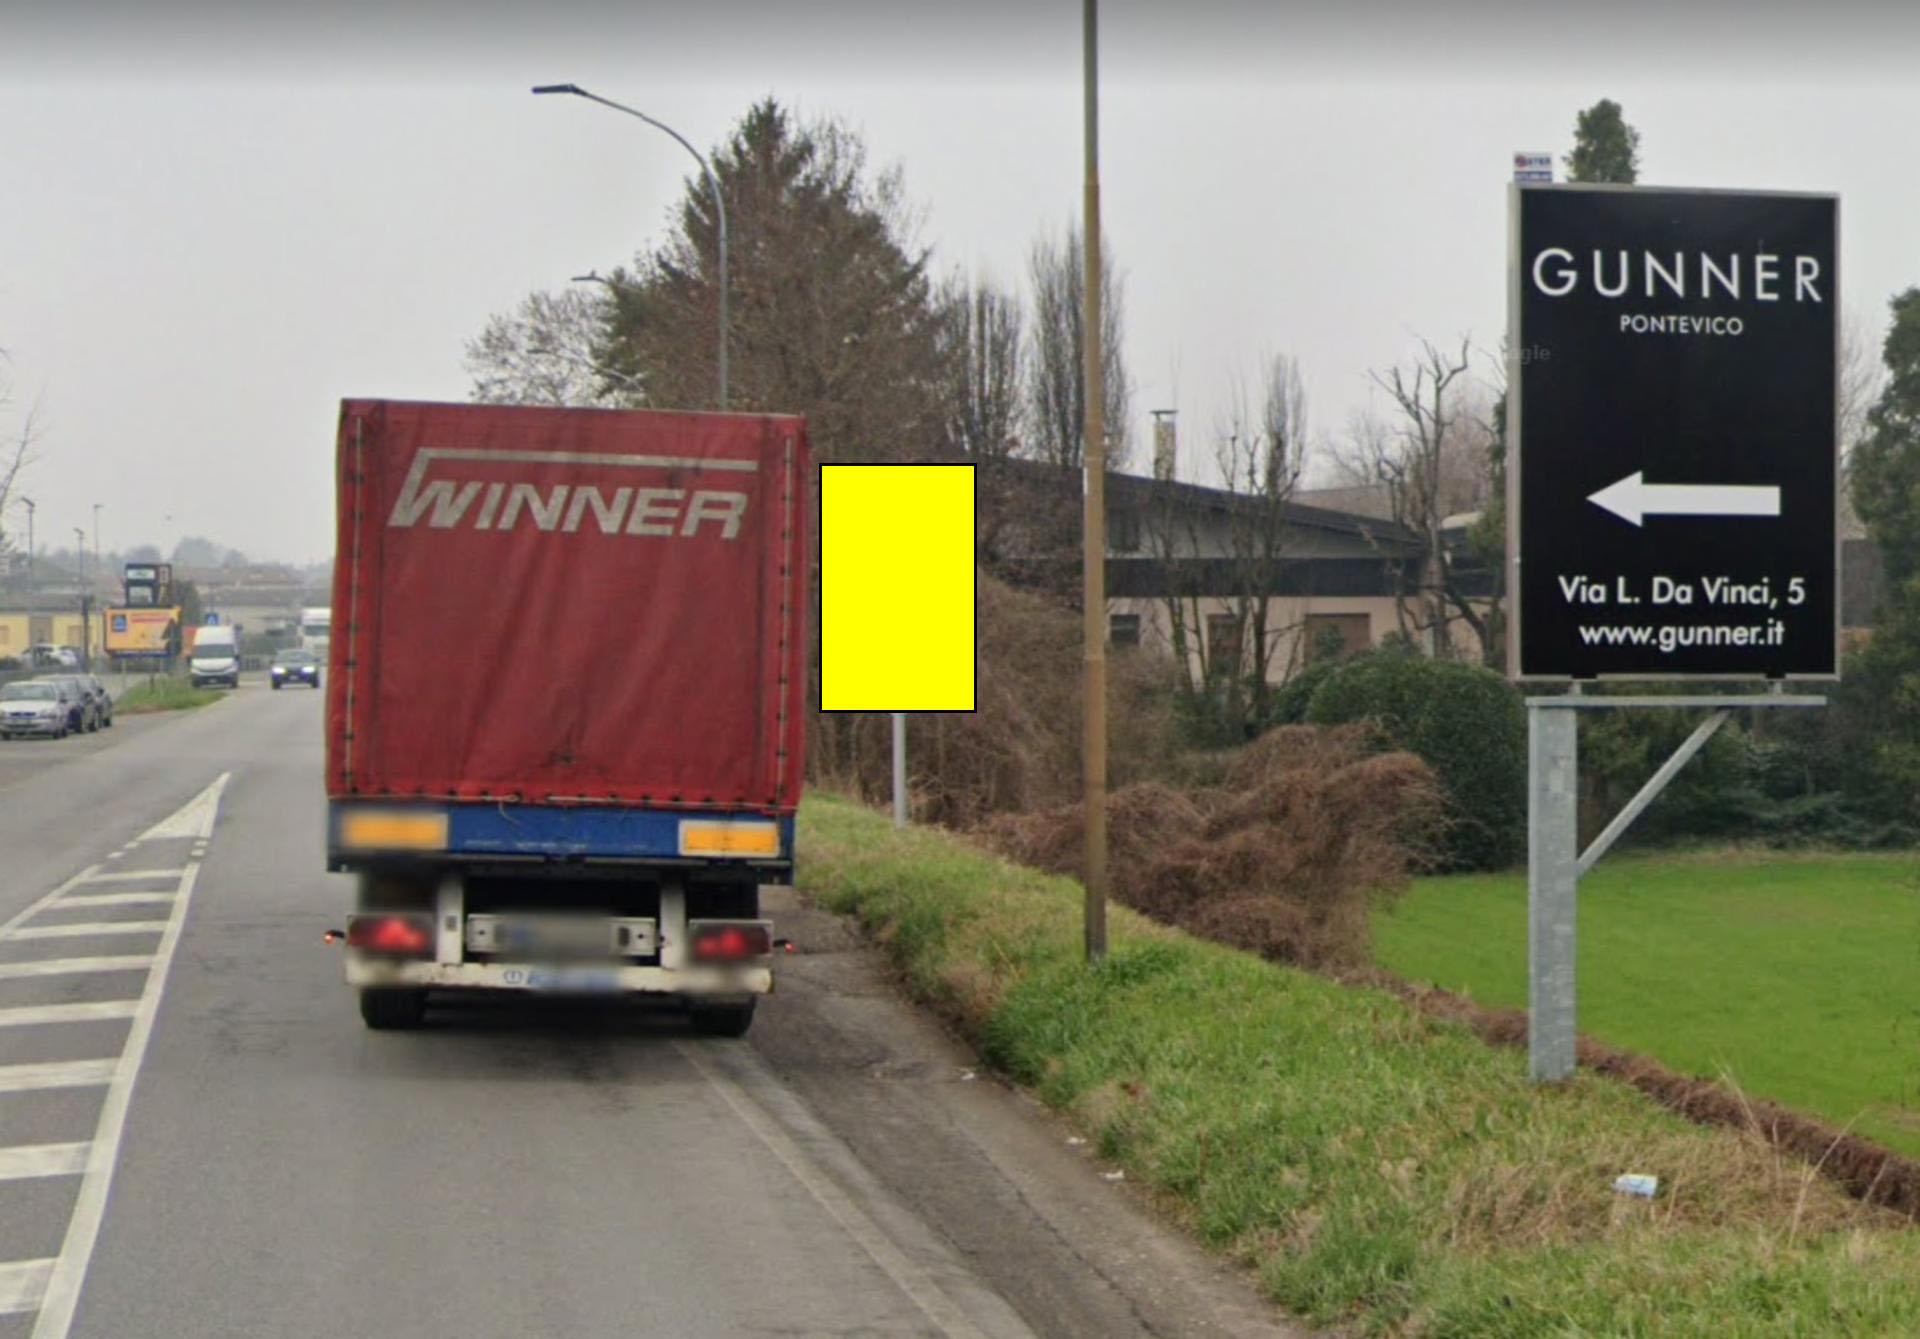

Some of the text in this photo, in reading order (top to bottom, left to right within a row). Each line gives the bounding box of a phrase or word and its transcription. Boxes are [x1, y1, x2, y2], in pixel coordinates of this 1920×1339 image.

[1532, 247, 1822, 303] GUNNER
[1620, 314, 1744, 336] PONTEVICO
[387, 476, 748, 539] WINNER
[1558, 575, 1806, 610] Via L. Da Vinci, 5
[1578, 617, 1785, 653] www.gunner.it
